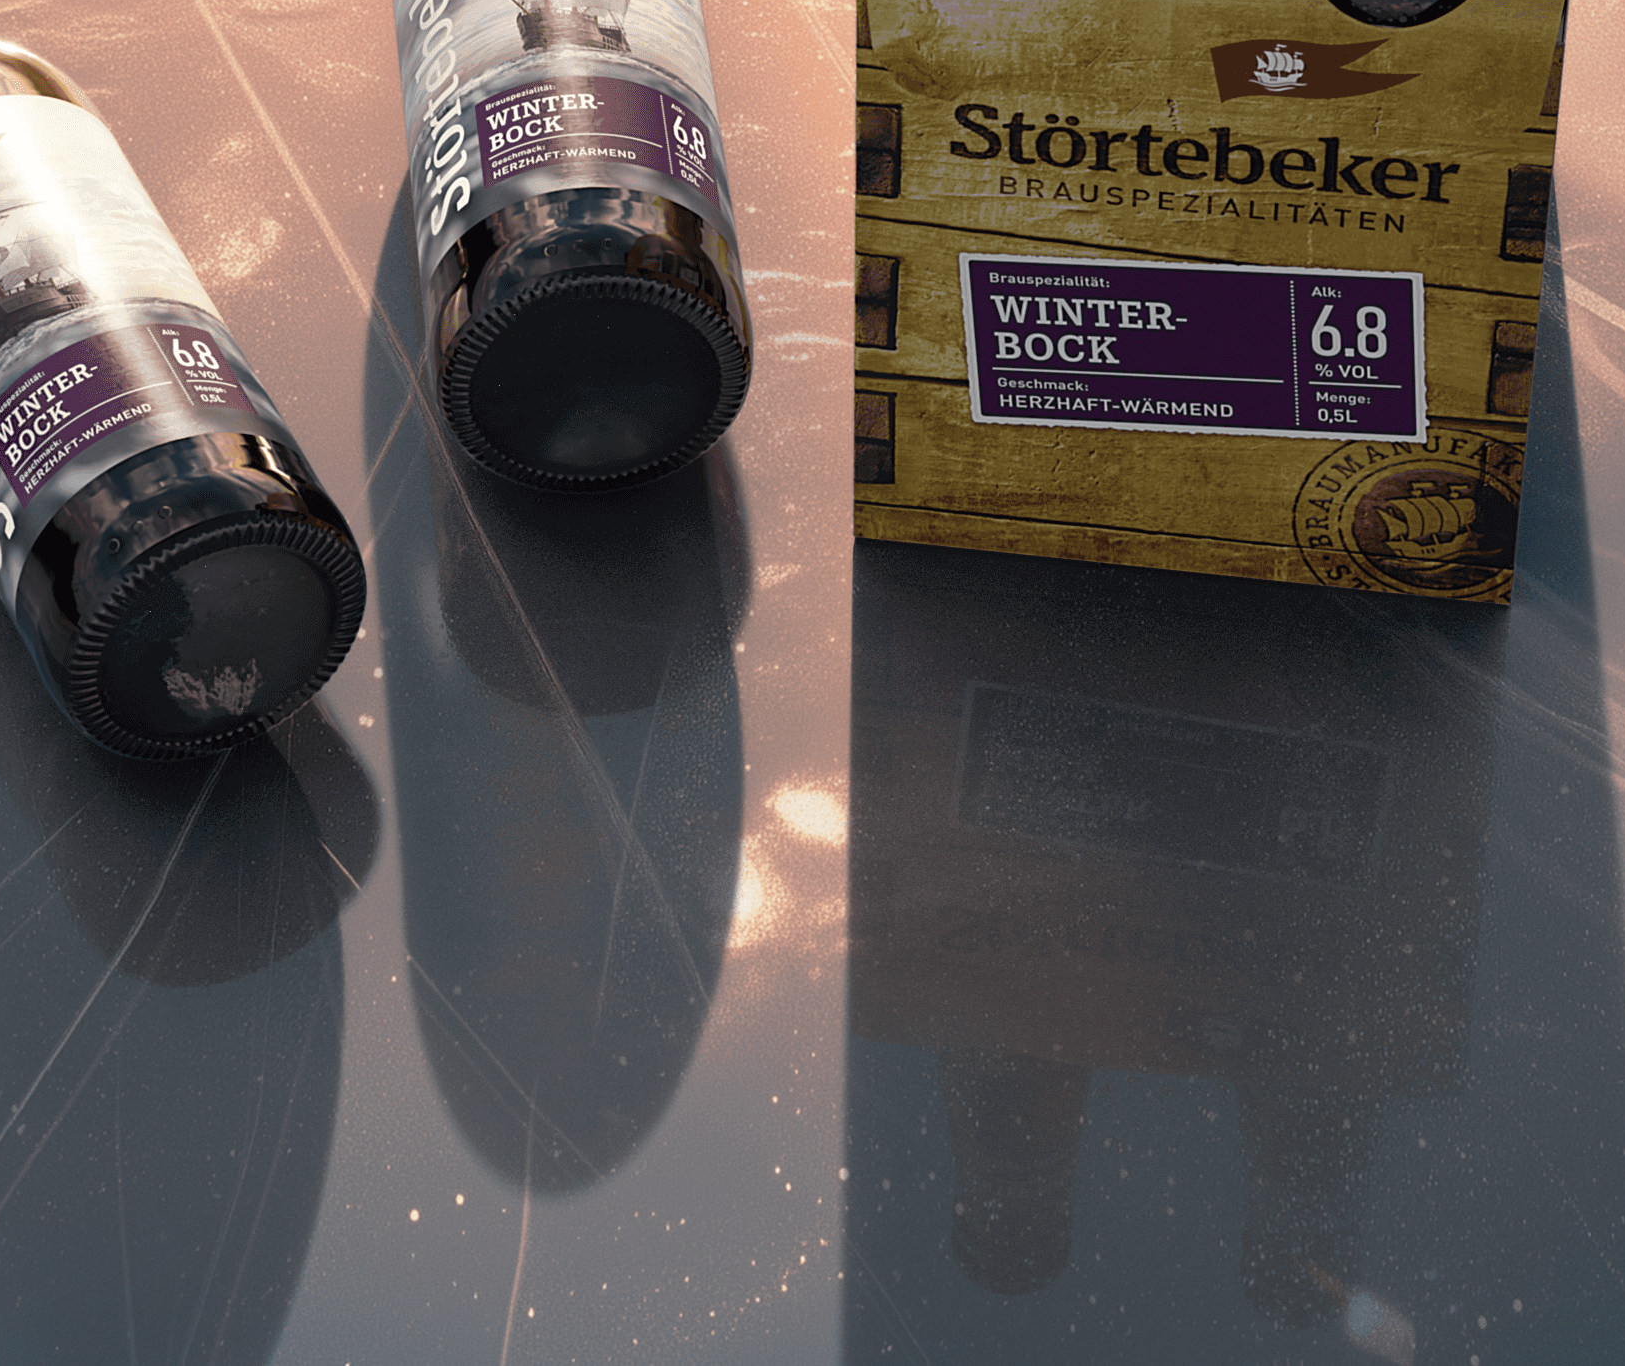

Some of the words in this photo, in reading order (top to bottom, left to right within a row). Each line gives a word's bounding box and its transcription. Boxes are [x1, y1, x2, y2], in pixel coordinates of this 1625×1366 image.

[485, 84, 557, 112] Brauspezialität:
[486, 93, 605, 131] WINTER-
[488, 115, 564, 153] BOCK
[673, 115, 707, 160] 6.8
[491, 145, 546, 168] Geschmack:
[492, 146, 637, 180] HERZHAFT-WÄRMEND
[949, 103, 1462, 204] Störtebeker
[999, 175, 1406, 234] BRAUSPEZIALITÄTEN
[988, 271, 1111, 289] Brauspezialität:
[1311, 285, 1342, 299] Alk:
[989, 294, 1188, 331] WINTER-
[993, 331, 1121, 365] BOCK
[1311, 304, 1388, 360] 6.8
[172, 338, 220, 370] 6.8
[198, 370, 224, 381] VOL
[997, 376, 1090, 392] Geschmack:
[1314, 363, 1334, 378] %
[1338, 364, 1379, 380] VOL
[999, 393, 1234, 418] HERZHAFT-WÄRMEND
[1315, 391, 1371, 406] Menge:
[1317, 408, 1358, 425] 0,5L
[4, 400, 72, 468] BOCK
[23, 403, 153, 495] HERZHAFT-WÄRMEND
[18, 438, 63, 484] Geschmack:
